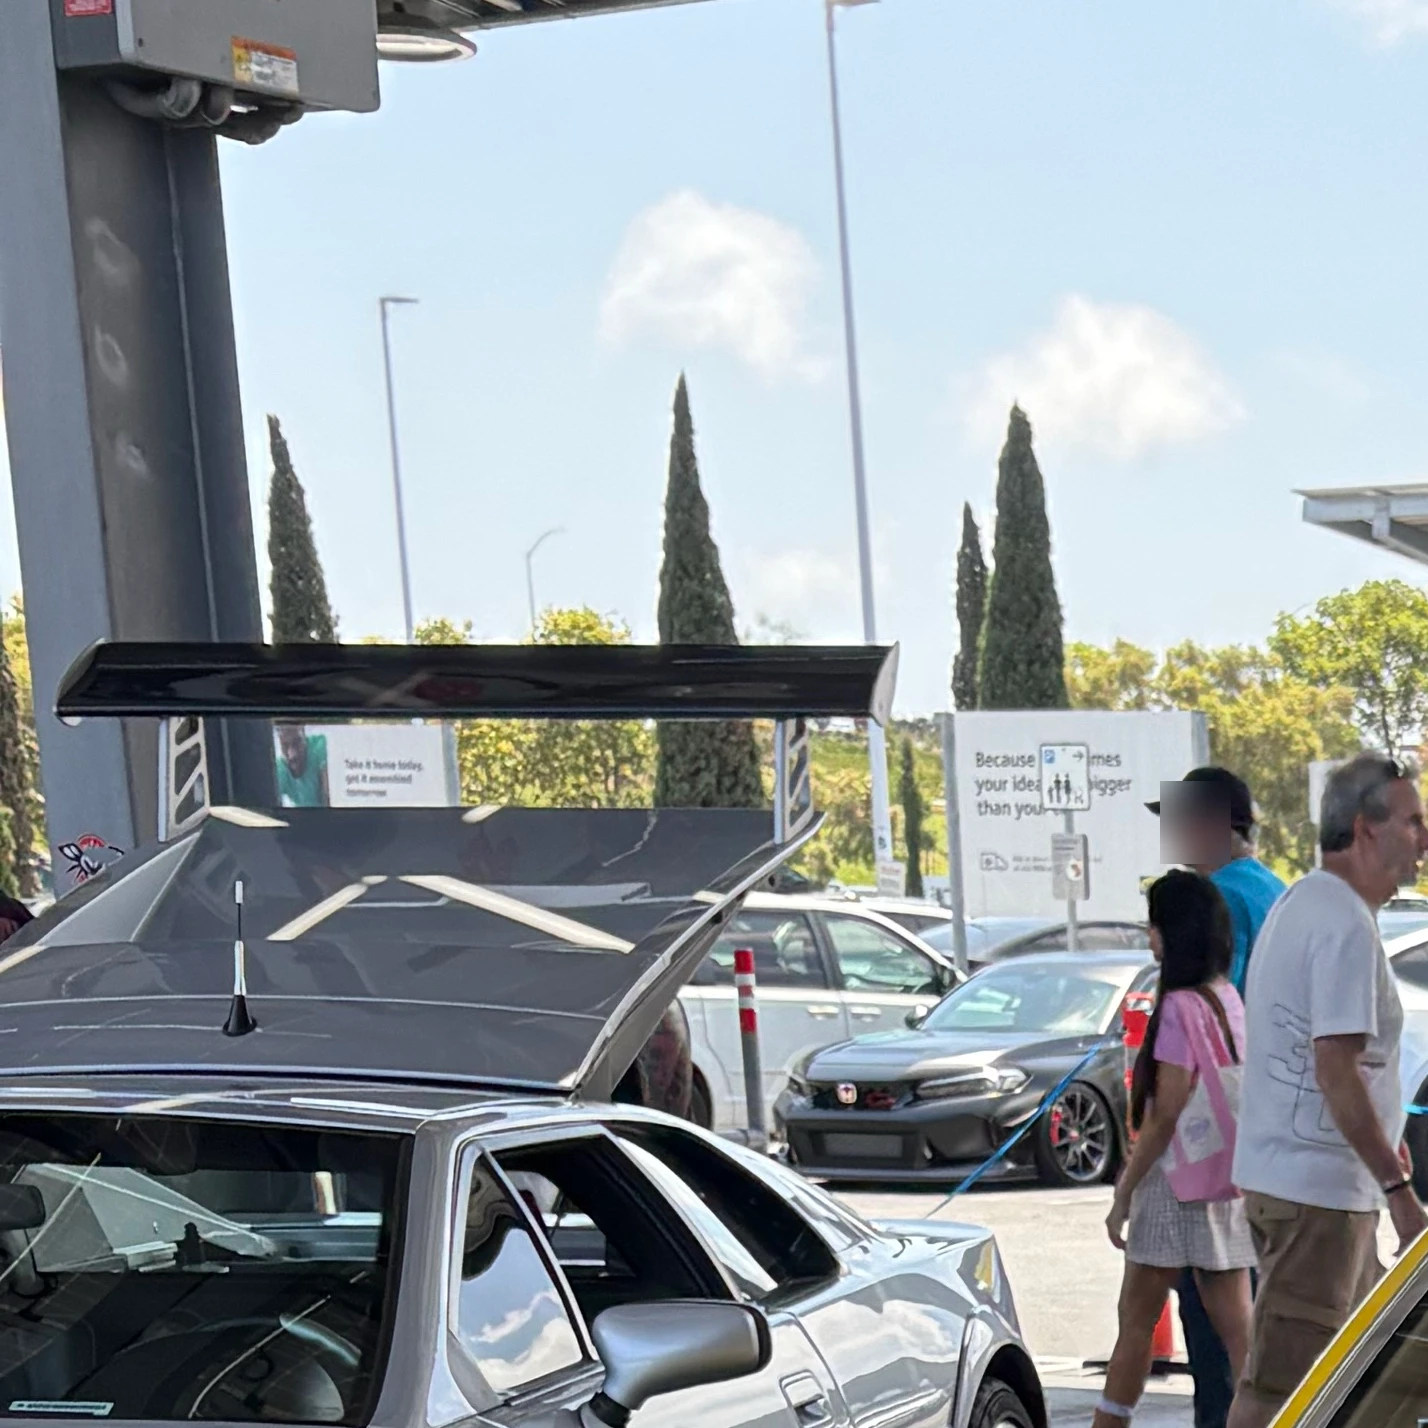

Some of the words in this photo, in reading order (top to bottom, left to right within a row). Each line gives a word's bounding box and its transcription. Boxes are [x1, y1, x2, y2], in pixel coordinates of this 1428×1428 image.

[976, 752, 1036, 768] Because
[975, 779, 1008, 797] your
[1013, 775, 1041, 792] idea
[977, 801, 1011, 817] than
